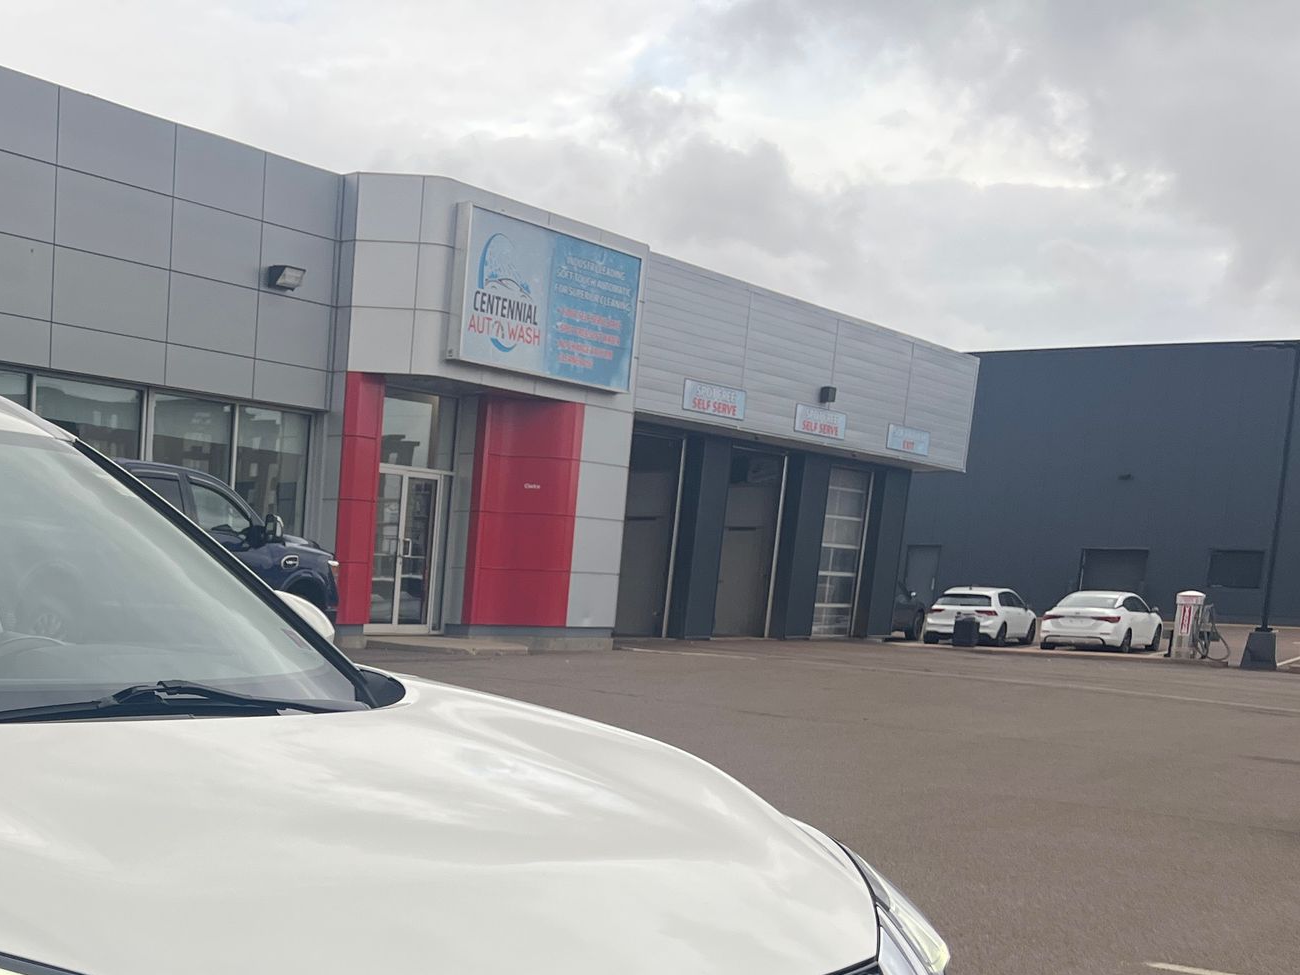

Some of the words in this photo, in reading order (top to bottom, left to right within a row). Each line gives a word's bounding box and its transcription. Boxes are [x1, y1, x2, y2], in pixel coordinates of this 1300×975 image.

[473, 290, 538, 326] CENTENNIAL
[507, 320, 541, 346] WASH
[692, 397, 711, 411] SELF
[712, 401, 737, 417] SERVE
[802, 419, 818, 433] SELF
[819, 422, 839, 437] SERVE
